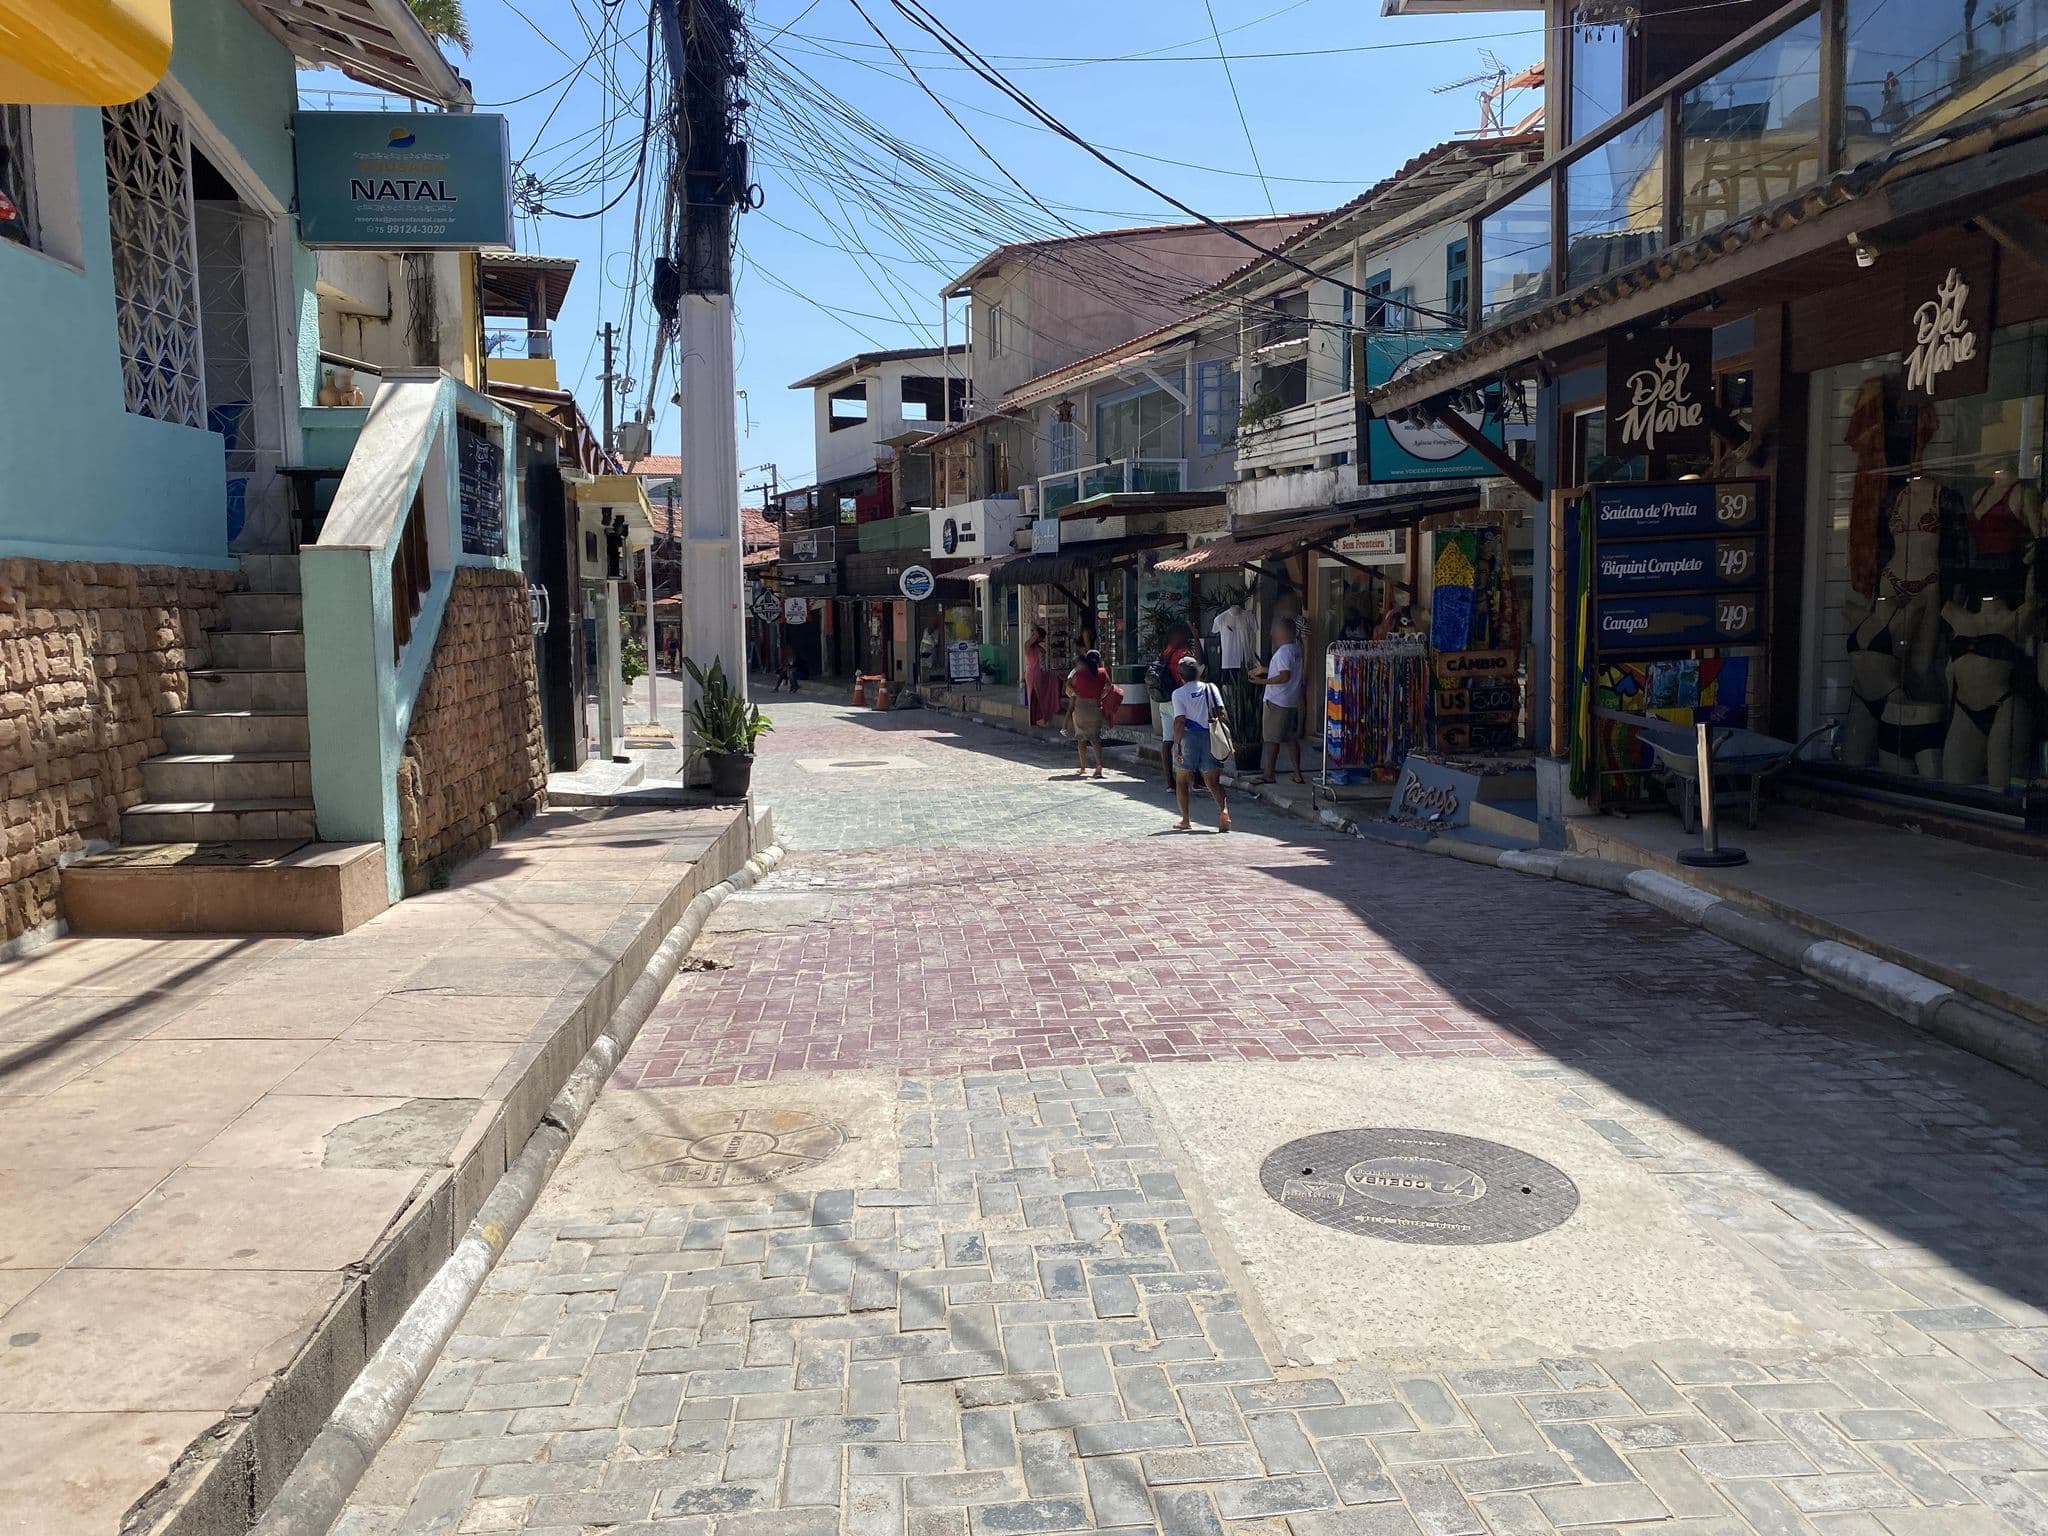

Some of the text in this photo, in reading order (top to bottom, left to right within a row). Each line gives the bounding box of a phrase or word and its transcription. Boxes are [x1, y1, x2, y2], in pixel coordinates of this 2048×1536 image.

[350, 178, 457, 202] NATAL
[375, 225, 445, 234] 75 99124-3020
[1913, 281, 1968, 343] Del
[1904, 332, 1976, 395] Mare
[1627, 363, 1690, 405] Del
[1615, 400, 1703, 450] Mare
[1601, 495, 1747, 520] Saídas de Praia 39
[1601, 549, 1748, 578] Biquini Completo 49
[1602, 605, 1748, 633] Cangas 49
[1446, 656, 1507, 671] CÂMBIO
[1352, 1174, 1426, 1189] COELBA
